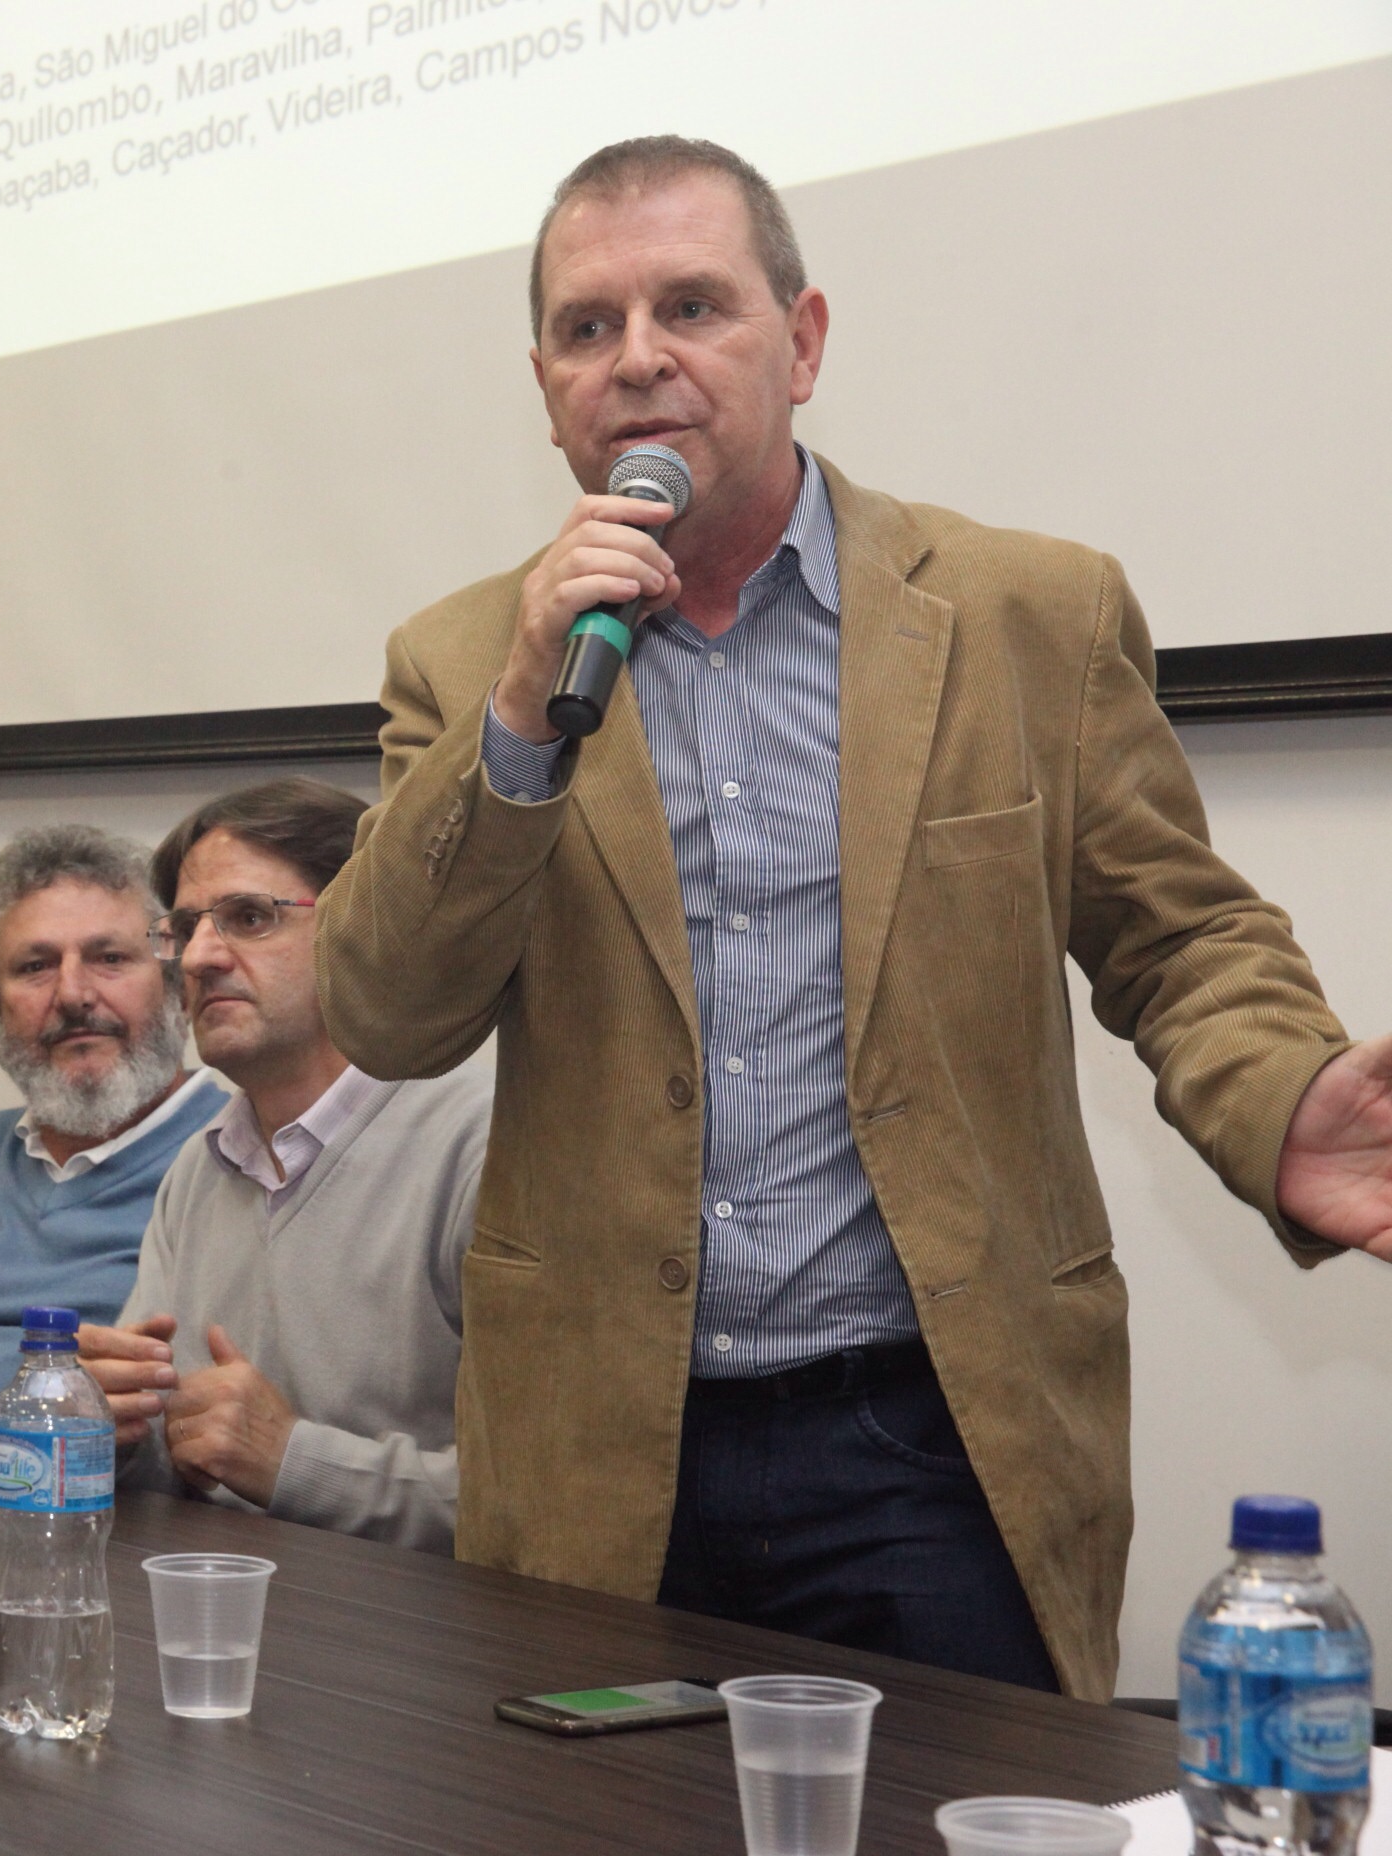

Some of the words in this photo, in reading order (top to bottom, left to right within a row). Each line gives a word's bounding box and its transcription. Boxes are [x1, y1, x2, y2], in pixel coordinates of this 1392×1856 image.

[34, 47, 94, 89] São
[104, 3, 208, 70] Miguel
[218, 0, 259, 32] do
[176, 25, 354, 102] Maravilha,
[112, 113, 258, 178] Caçador,
[267, 73, 403, 133] Videira,
[415, 19, 584, 94] Campos
